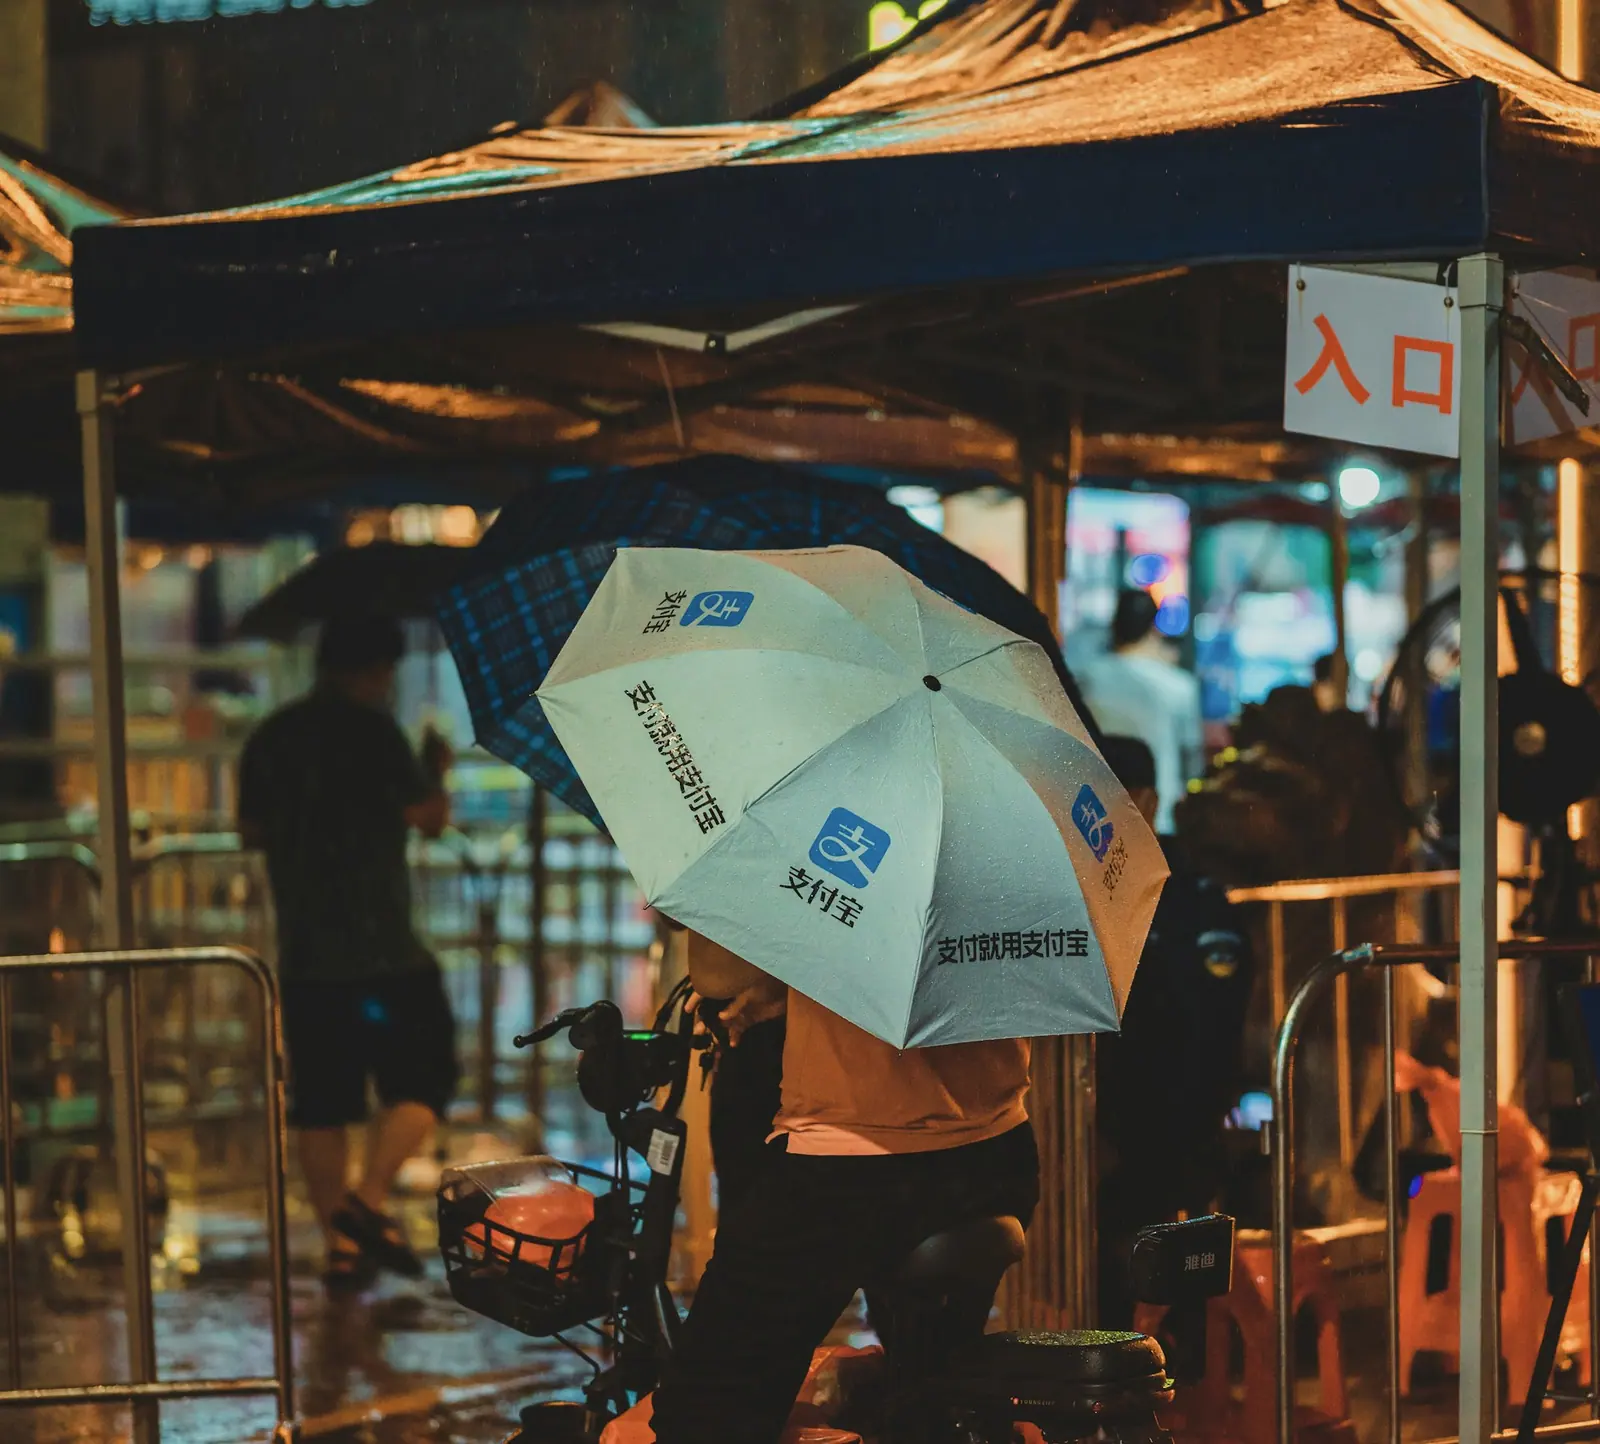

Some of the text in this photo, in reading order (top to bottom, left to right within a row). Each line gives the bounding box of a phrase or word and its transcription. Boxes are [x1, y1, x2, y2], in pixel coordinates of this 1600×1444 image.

[1294, 312, 1454, 414] 入口
[642, 589, 687, 634] 支付宝
[624, 680, 726, 834] 支付就用支付宝
[779, 865, 864, 928] 支付宝
[937, 928, 1089, 966] 支付就用支付宝
[1184, 1252, 1215, 1271] 雅迪
